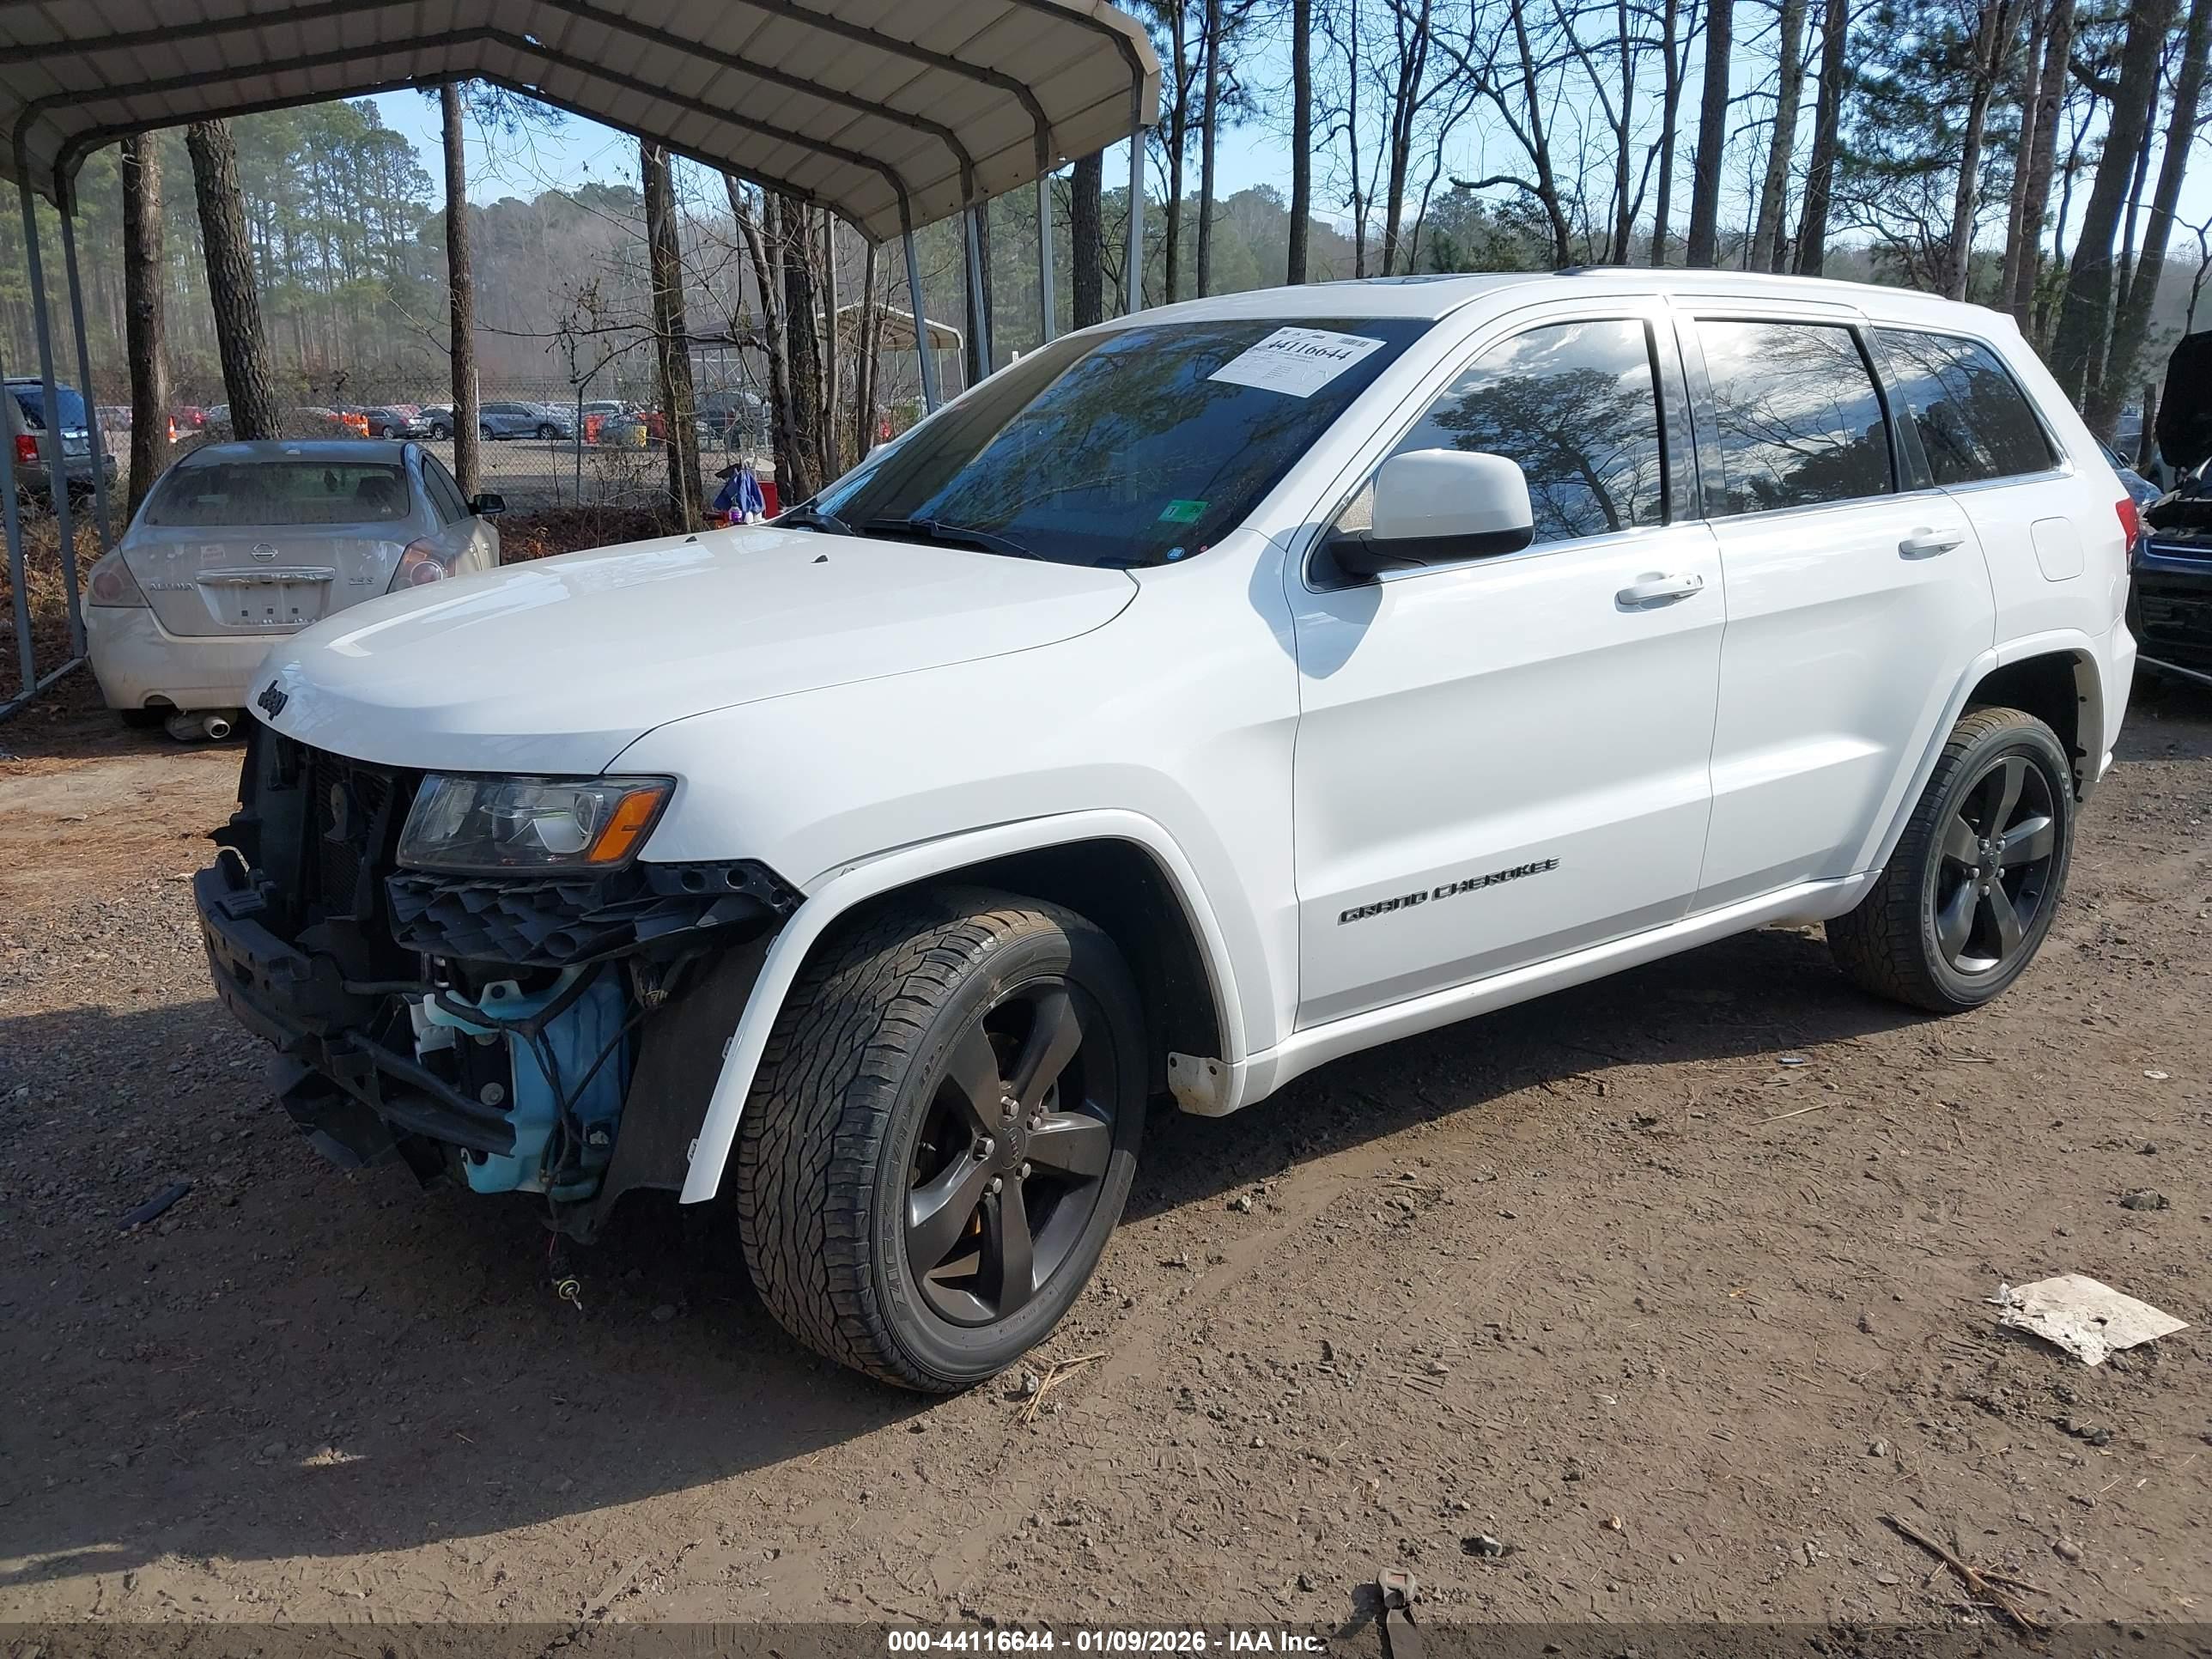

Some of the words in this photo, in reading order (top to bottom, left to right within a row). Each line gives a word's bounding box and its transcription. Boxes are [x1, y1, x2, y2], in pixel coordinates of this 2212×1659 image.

[1267, 339, 1354, 361] 44116644
[1337, 890, 1429, 926] GRAND
[1431, 855, 1561, 901] CHEROKEE
